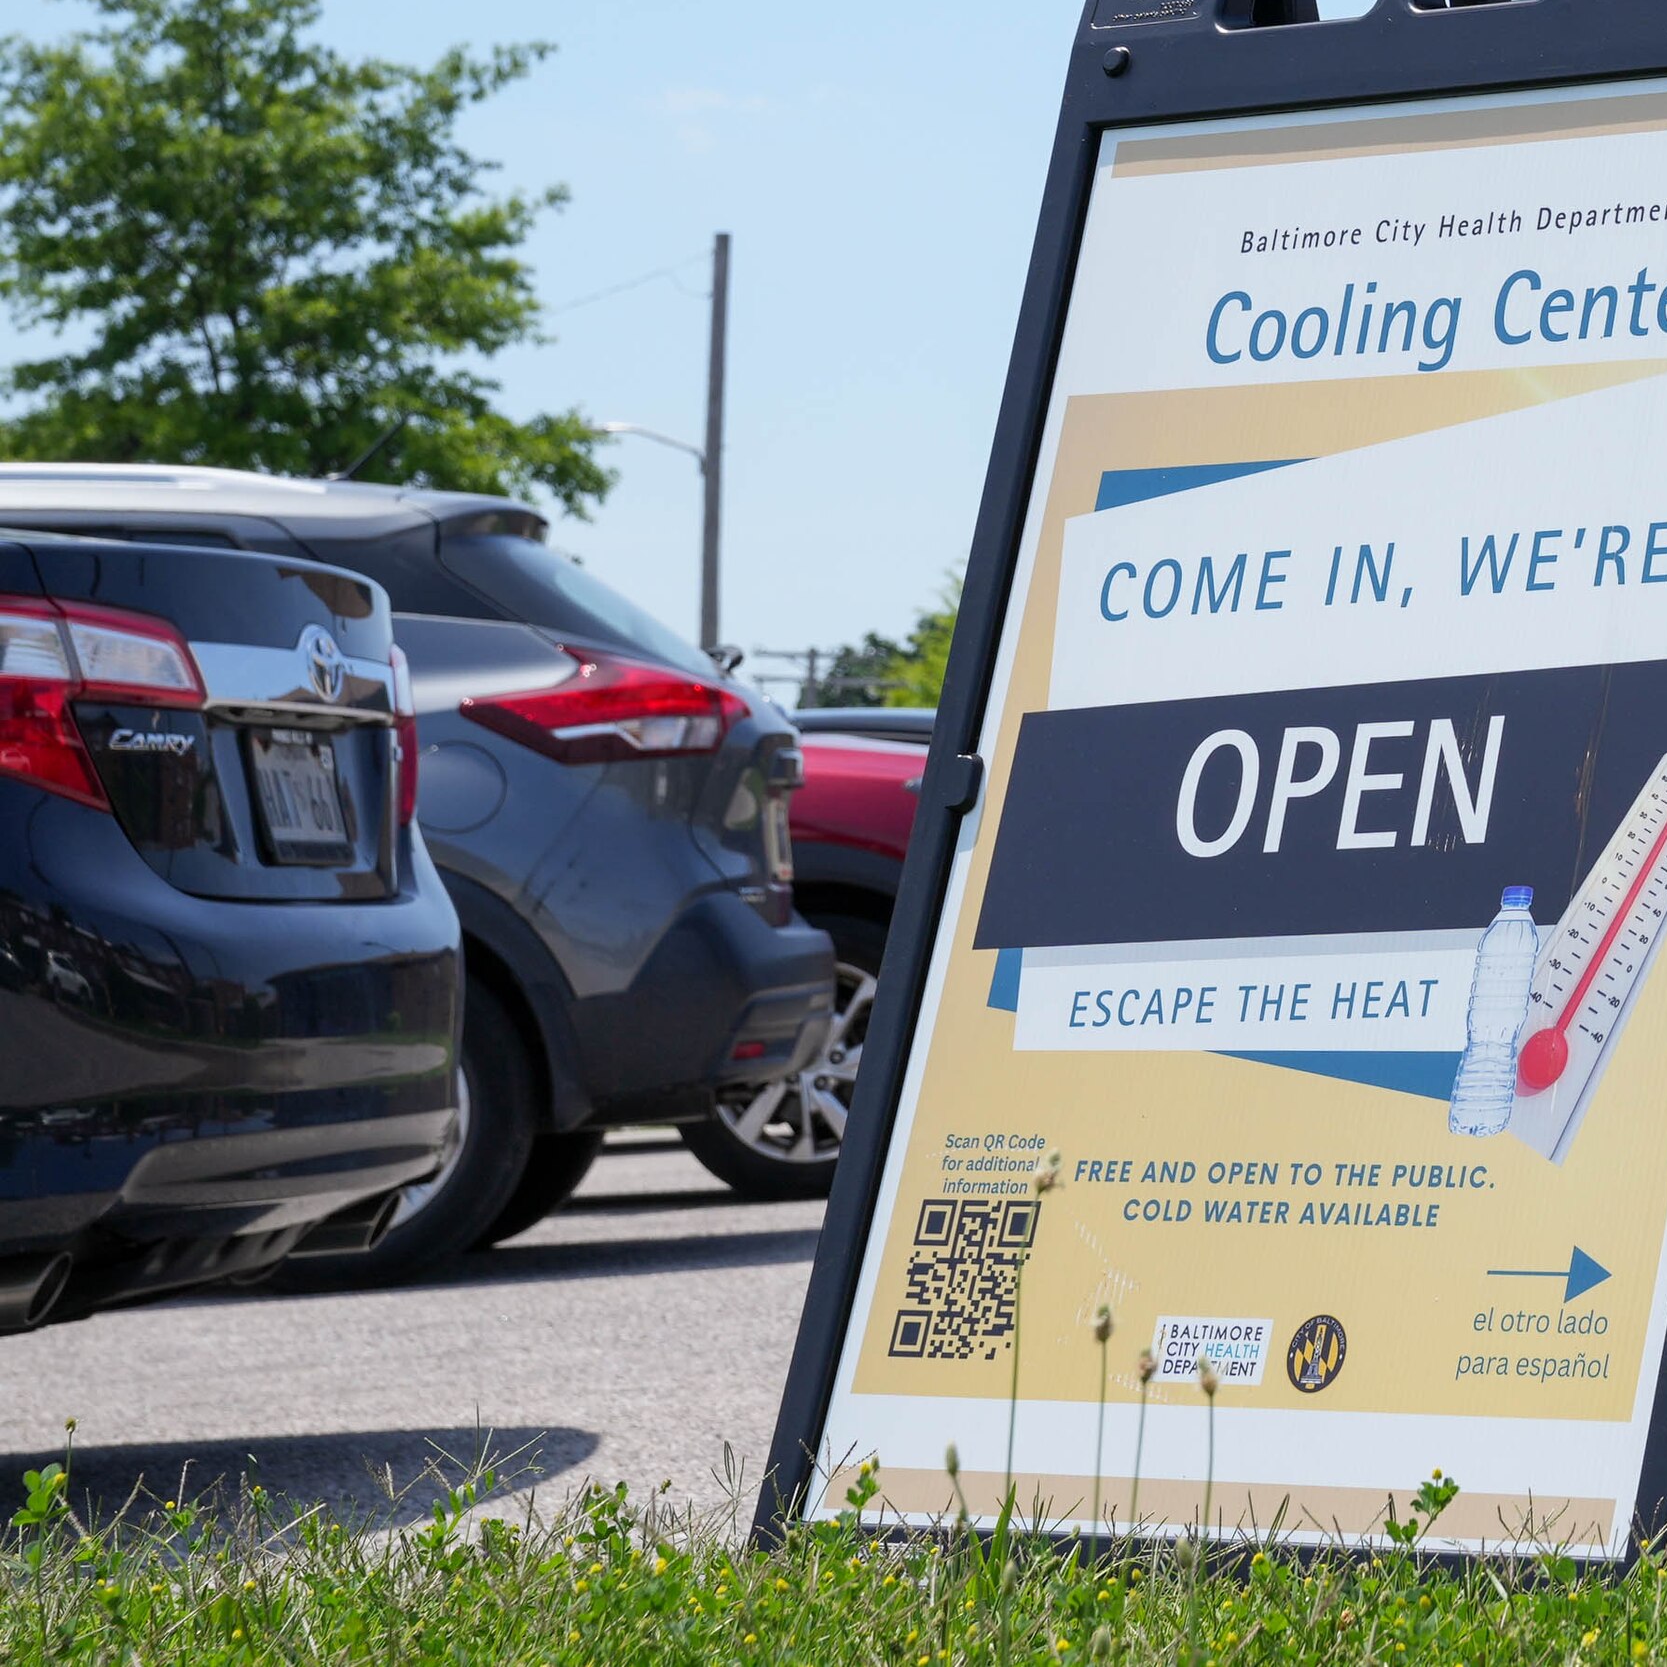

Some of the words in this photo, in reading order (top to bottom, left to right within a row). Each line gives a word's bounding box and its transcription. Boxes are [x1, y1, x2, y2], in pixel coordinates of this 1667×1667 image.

[1239, 224, 1362, 254] Baltimore
[1374, 218, 1426, 247] City
[1438, 210, 1522, 239] Health
[1204, 280, 1462, 372] Cooling
[1099, 549, 1292, 622] COME
[1323, 542, 1413, 609] IN,
[109, 729, 196, 756] CAMRY
[1176, 715, 1505, 858] OPEN
[1638, 934, 1649, 945] 20
[1068, 986, 1218, 1028] ESCAPE
[1238, 984, 1311, 1022] THE
[1331, 979, 1439, 1020] HEAT
[1607, 996, 1620, 1009] -20
[1590, 1031, 1604, 1044] -40
[945, 1134, 980, 1149] Scan
[984, 1134, 1005, 1152] QR
[1008, 1134, 1046, 1149] Code
[941, 1155, 963, 1171] for
[965, 1156, 1040, 1172] additional
[1074, 1159, 1133, 1183] FREE
[1141, 1160, 1197, 1183] AND
[1207, 1162, 1279, 1186] OPEN
[1289, 1163, 1323, 1187] TO
[1334, 1164, 1382, 1188] THE
[1391, 1165, 1496, 1190] PUBLIC.
[942, 1178, 1028, 1194] information
[1123, 1199, 1193, 1222] COLD
[1203, 1200, 1290, 1224] WATER
[1299, 1202, 1440, 1228] AVAILABLE
[1170, 1324, 1264, 1342] BALTIMORE
[1305, 1319, 1316, 1329] OF
[1316, 1317, 1345, 1351] BALTIMORE
[1473, 1306, 1494, 1332] el
[1501, 1310, 1550, 1333] otro
[1557, 1308, 1608, 1335] lado
[1166, 1342, 1200, 1357] CITY
[1204, 1343, 1260, 1358] HEALTH
[1455, 1354, 1508, 1381] para
[1516, 1352, 1610, 1384] español
